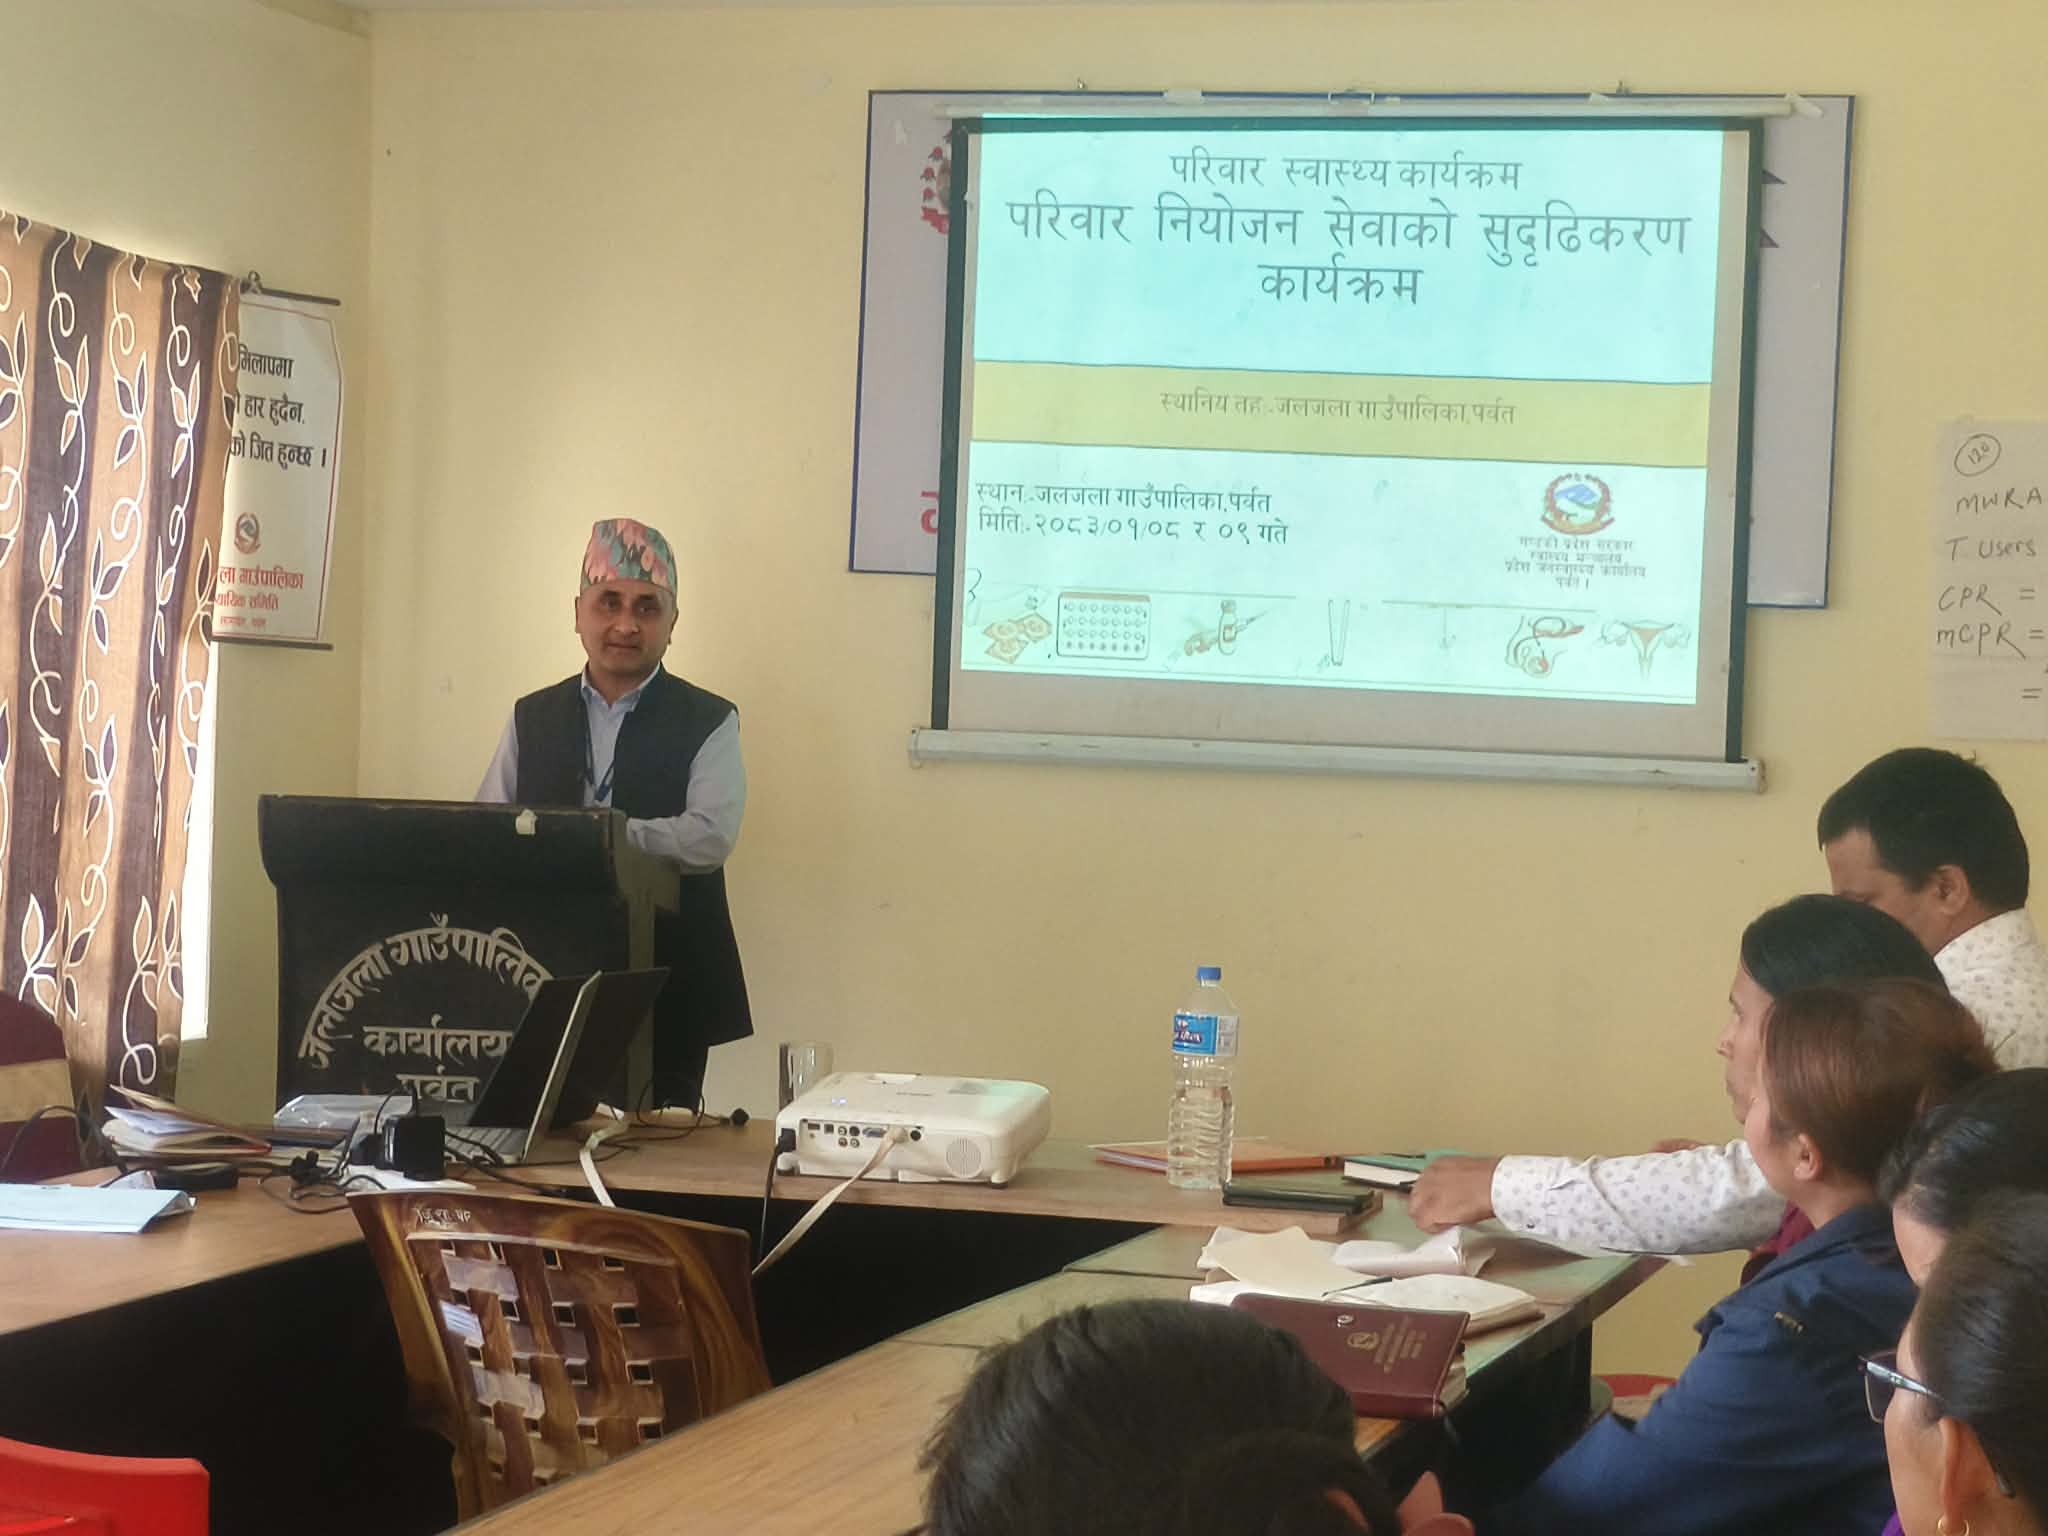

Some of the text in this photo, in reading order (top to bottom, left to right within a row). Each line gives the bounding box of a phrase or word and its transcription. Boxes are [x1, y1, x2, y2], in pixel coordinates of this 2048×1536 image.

[1170, 145, 1524, 191] परिवार स्वास्थ्य कार्यक्रम
[1005, 188, 1692, 268] परिवार नियोजन सेवाको सुदृढिकरण
[1257, 252, 1424, 305] कार्यक्रम
[239, 343, 295, 379] मिलापमा
[244, 393, 266, 418] हार
[249, 432, 275, 462] जित
[1193, 521, 1206, 541] र
[1218, 522, 1250, 544] ०९
[1258, 517, 1288, 545] गते
[1946, 535, 2038, 561] T Users
[1938, 583, 2002, 616] CPR
[298, 911, 554, 1069] जलजला गाउँपालिक
[362, 1013, 513, 1066] कार्यालय
